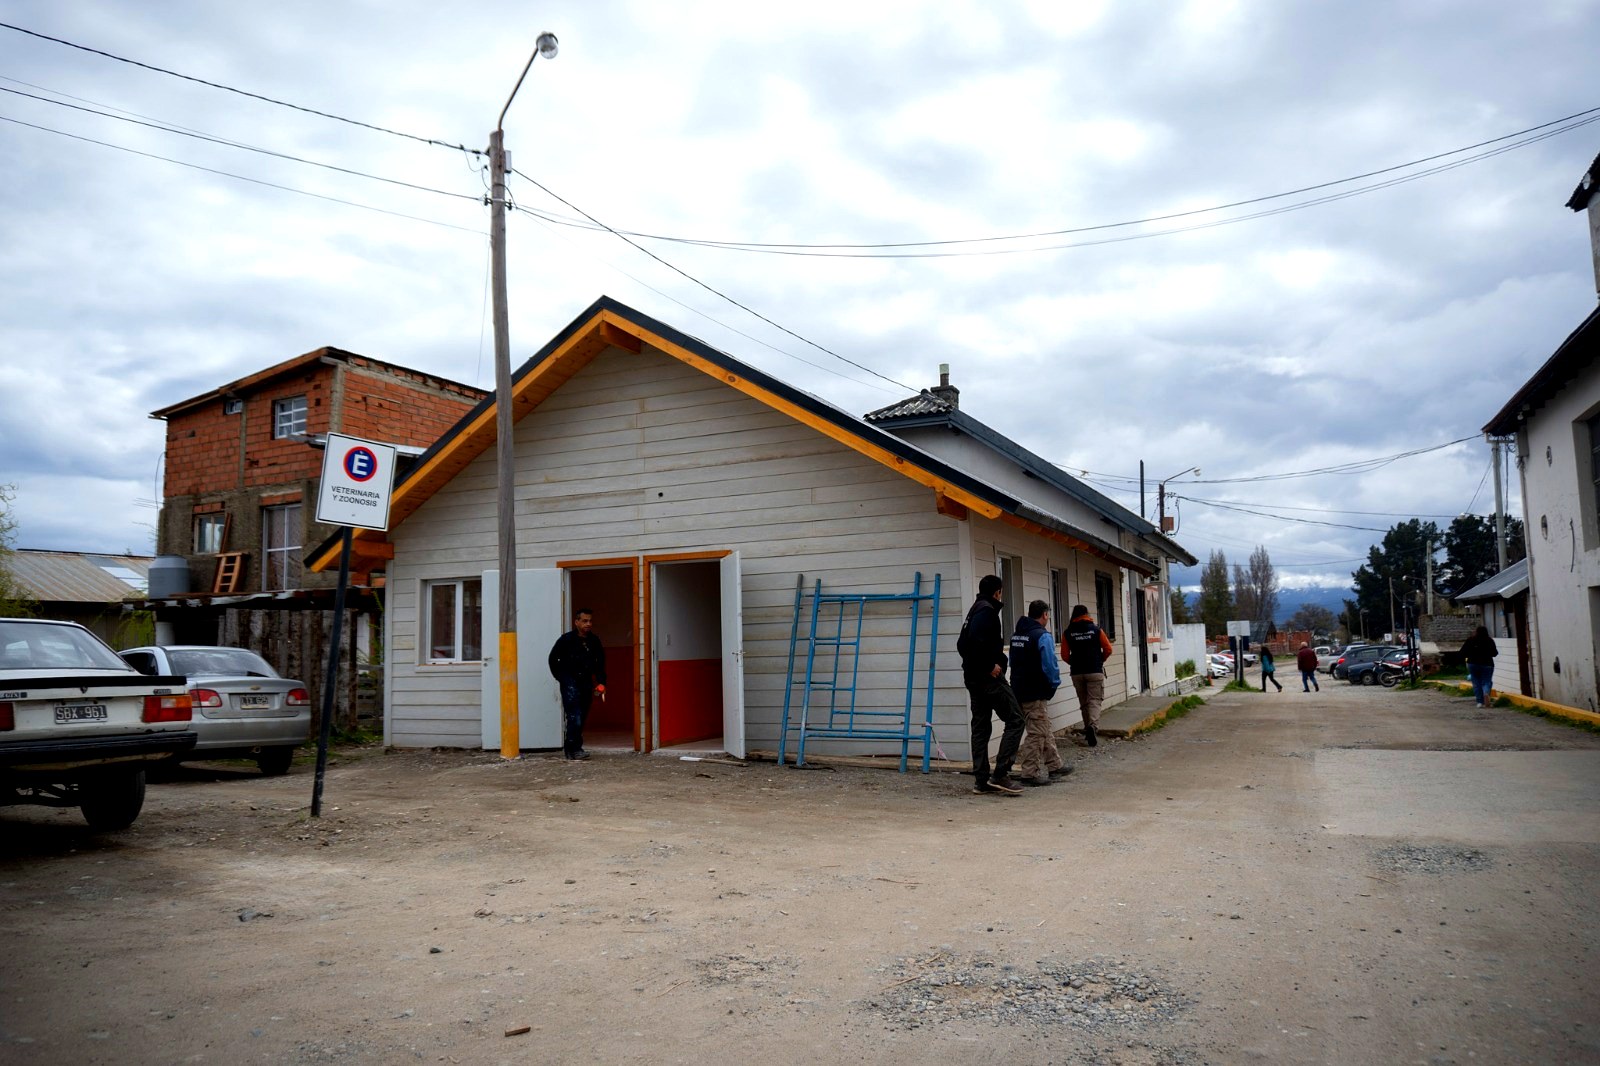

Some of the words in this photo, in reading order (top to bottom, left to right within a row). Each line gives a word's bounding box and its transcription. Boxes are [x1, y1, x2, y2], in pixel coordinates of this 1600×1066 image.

[352, 453, 369, 476] E
[331, 486, 380, 499] VETERINARIA
[338, 495, 377, 507] ZOONOSIS
[56, 707, 78, 720] SBX
[84, 706, 106, 718] 961
